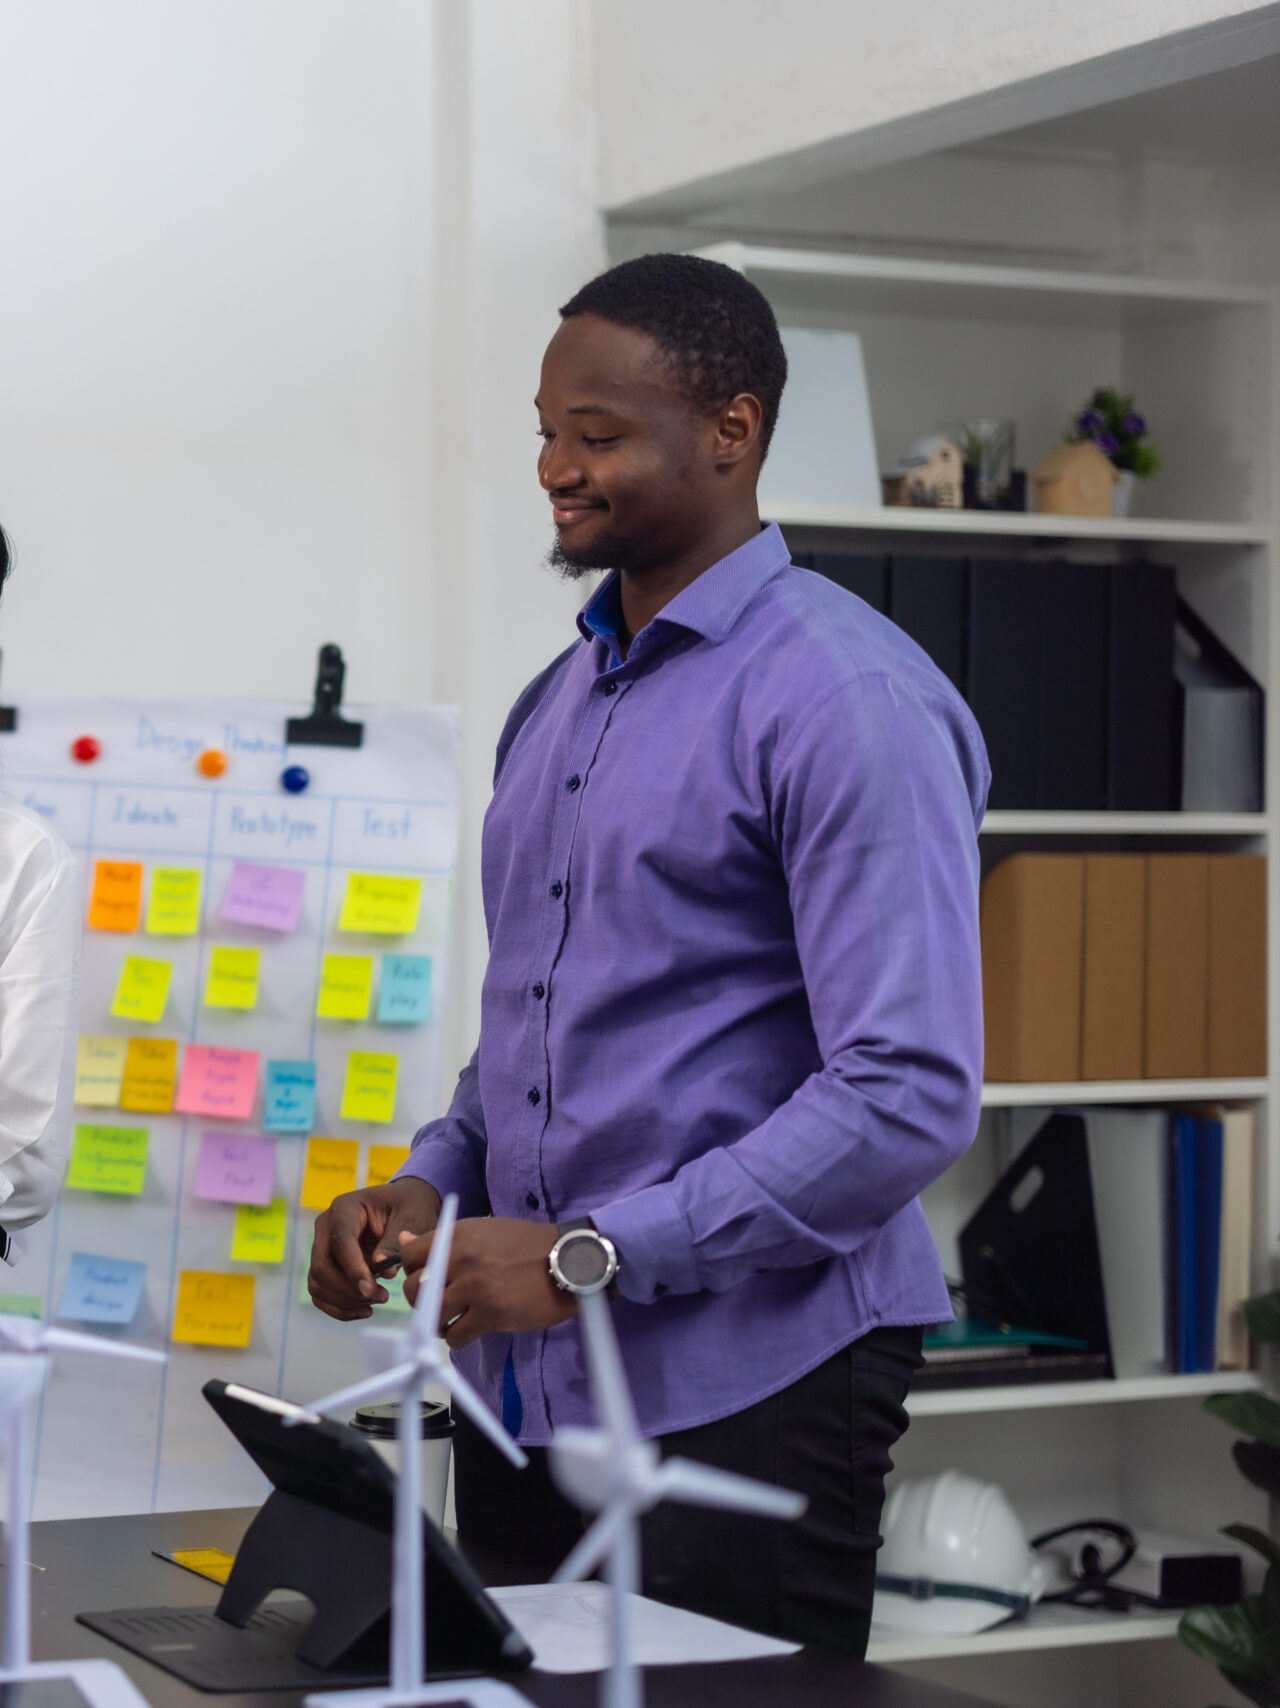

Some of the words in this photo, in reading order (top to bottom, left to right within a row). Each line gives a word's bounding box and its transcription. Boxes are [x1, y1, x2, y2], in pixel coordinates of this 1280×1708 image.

[136, 714, 206, 763] Design
[230, 805, 317, 847] Prototype
[361, 807, 413, 838] Test
